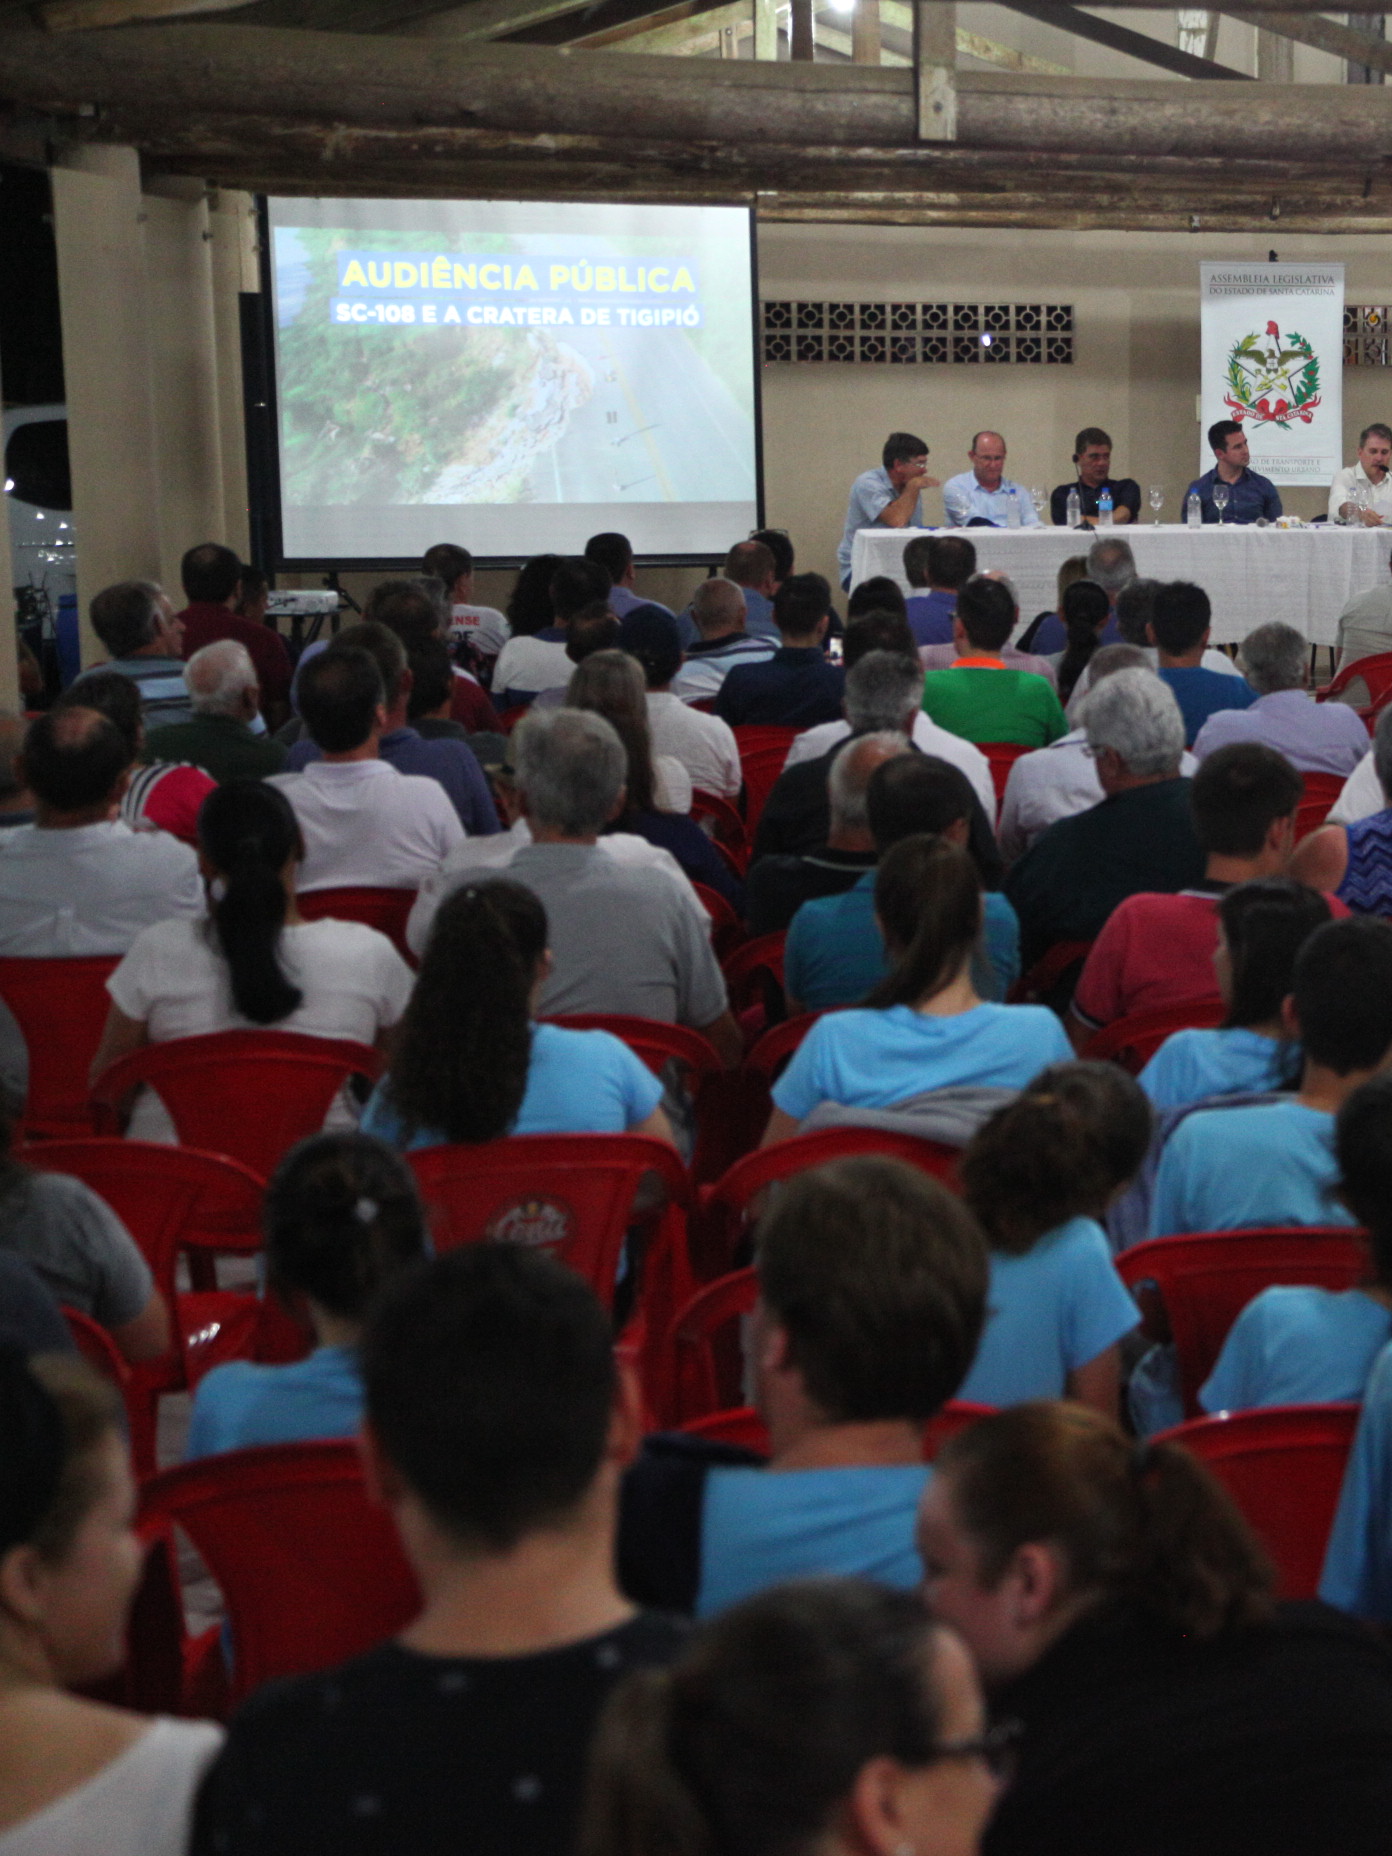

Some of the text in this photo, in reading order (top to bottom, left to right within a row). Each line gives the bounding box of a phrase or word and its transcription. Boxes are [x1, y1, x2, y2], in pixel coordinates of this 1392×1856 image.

[342, 256, 696, 293] AUDIÊNCIA PÚBLICA
[1210, 274, 1335, 284] ASSEMBLEIA LEGISLATIVA
[1210, 287, 1335, 296] DO ESTADO DE SANTA CATARINA
[336, 303, 700, 326] SC-108 E A CRATERA DE TIGIPIÓ
